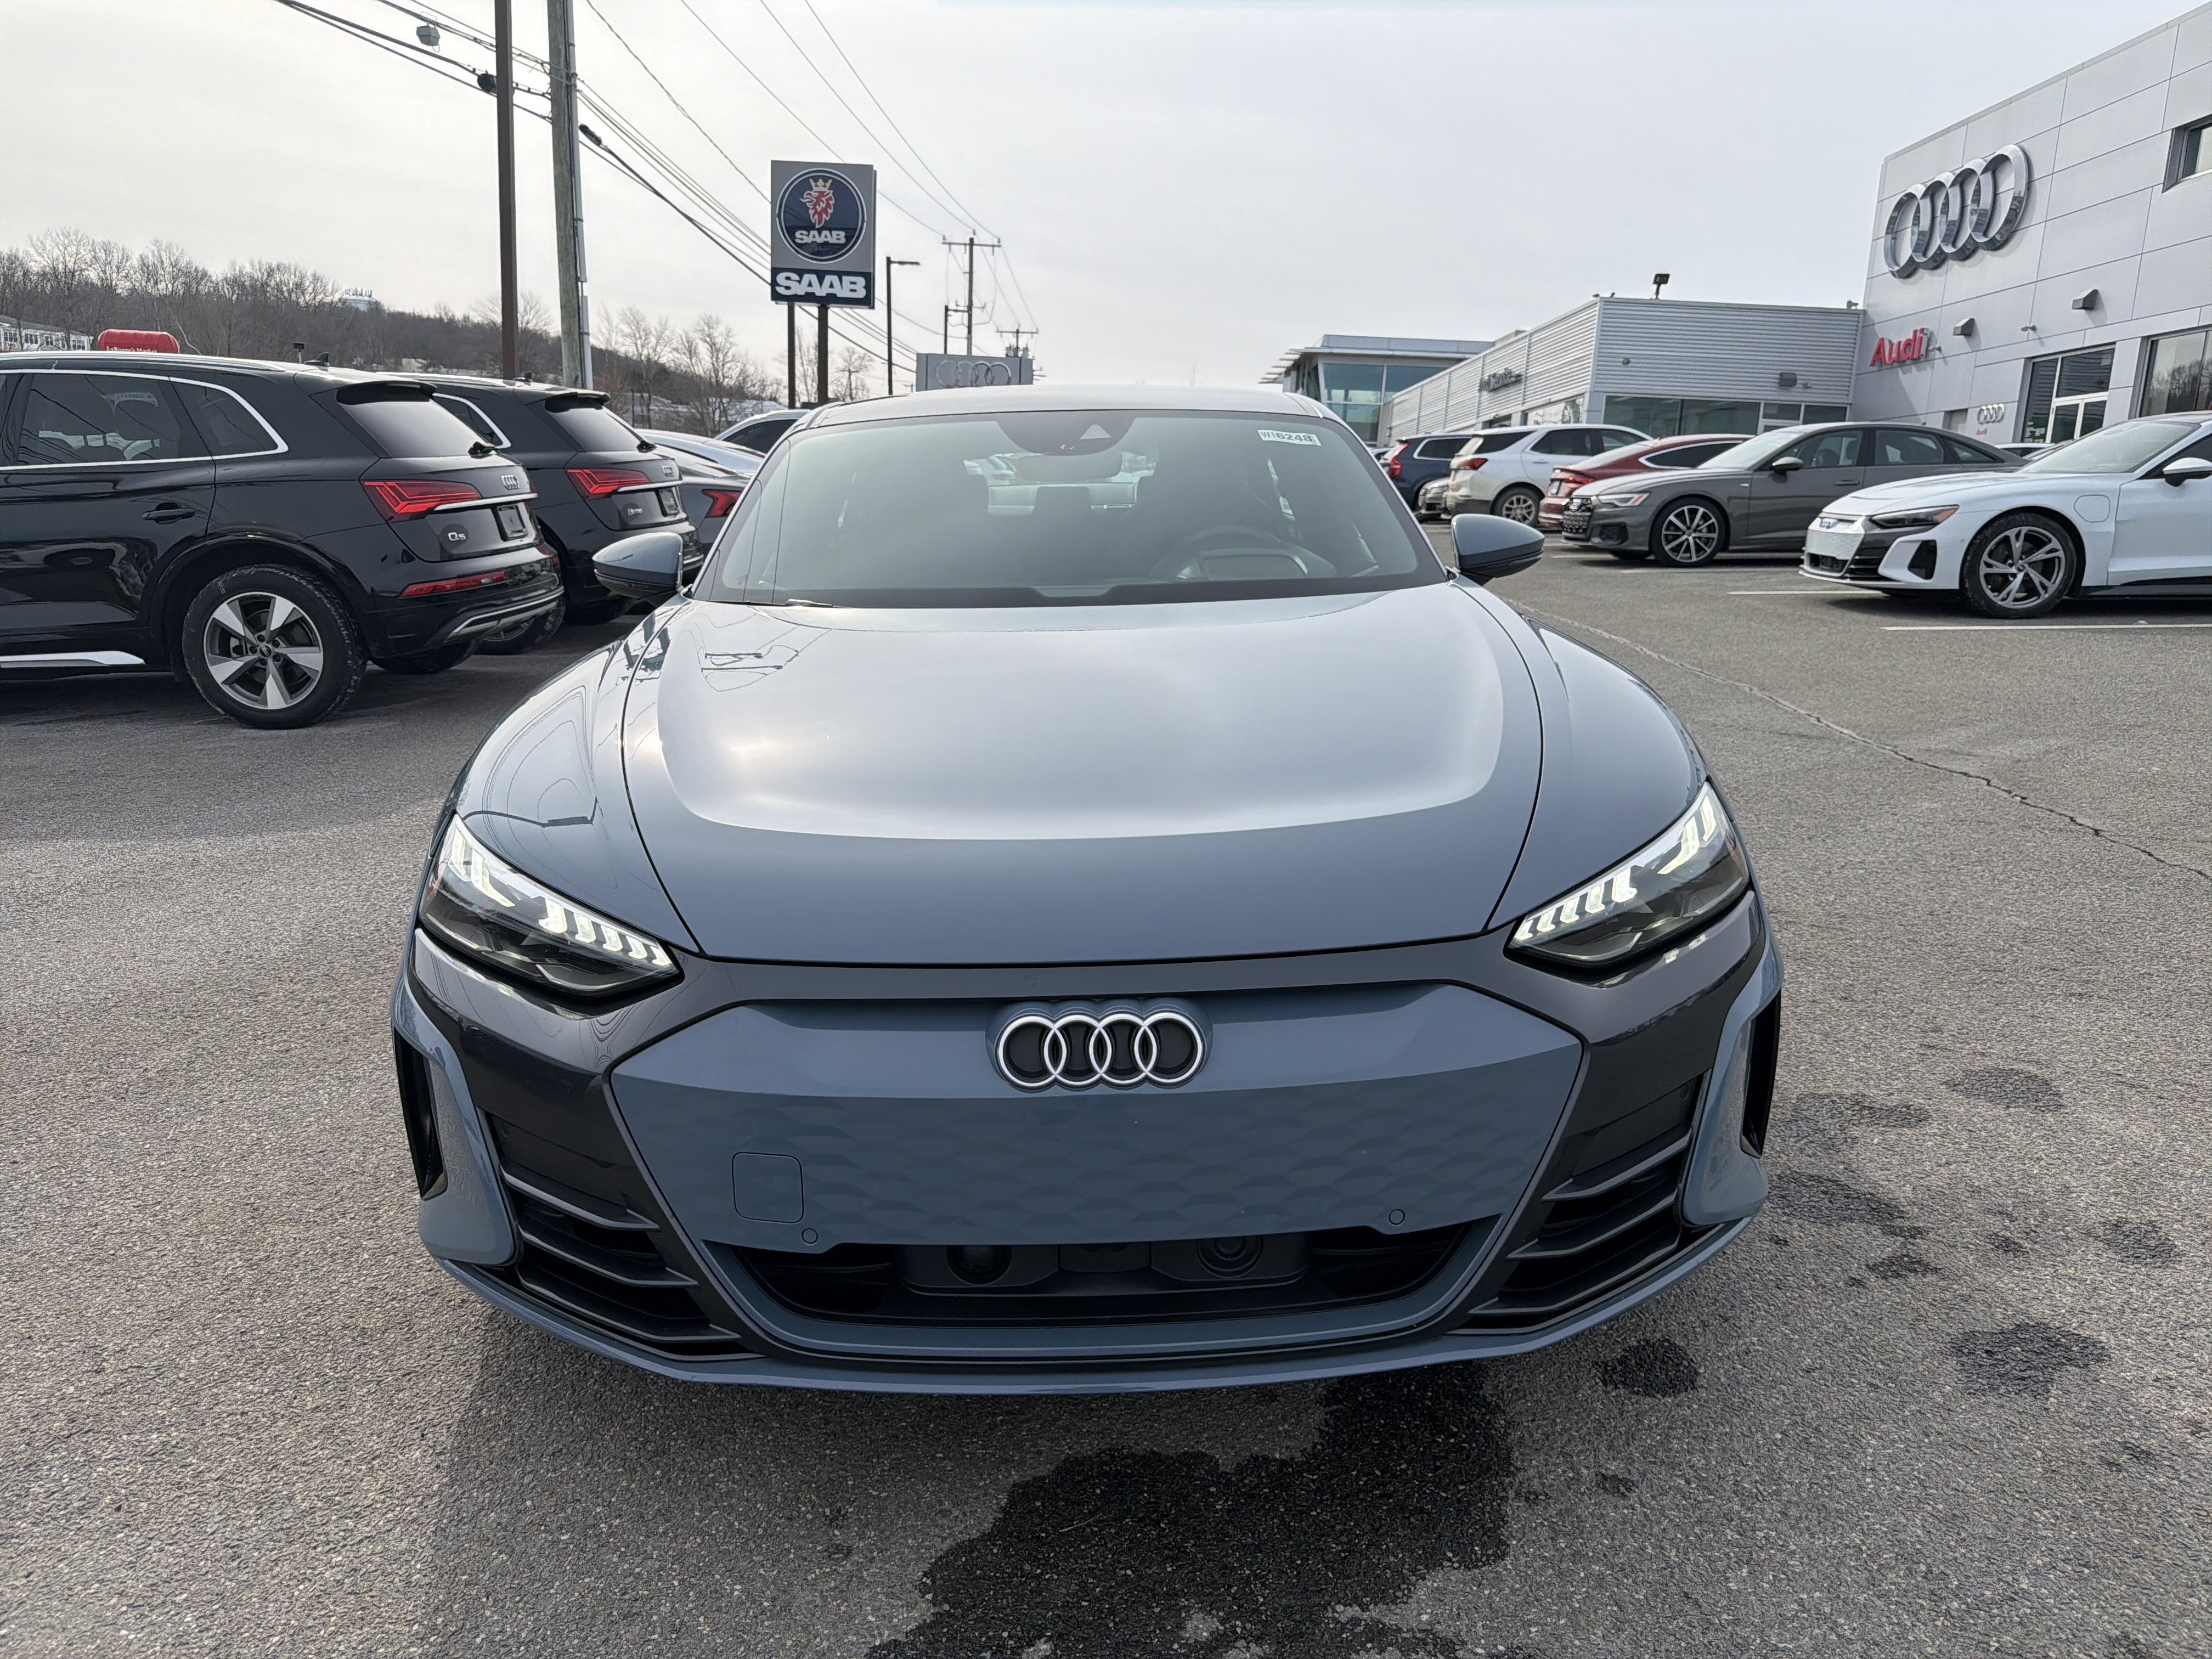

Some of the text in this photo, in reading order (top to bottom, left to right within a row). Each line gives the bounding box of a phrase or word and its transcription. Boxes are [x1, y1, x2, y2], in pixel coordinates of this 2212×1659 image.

[795, 230, 846, 244] SAAB
[775, 272, 867, 298] SAAB
[1870, 328, 1925, 366] Audi
[448, 532, 466, 541] Q5
